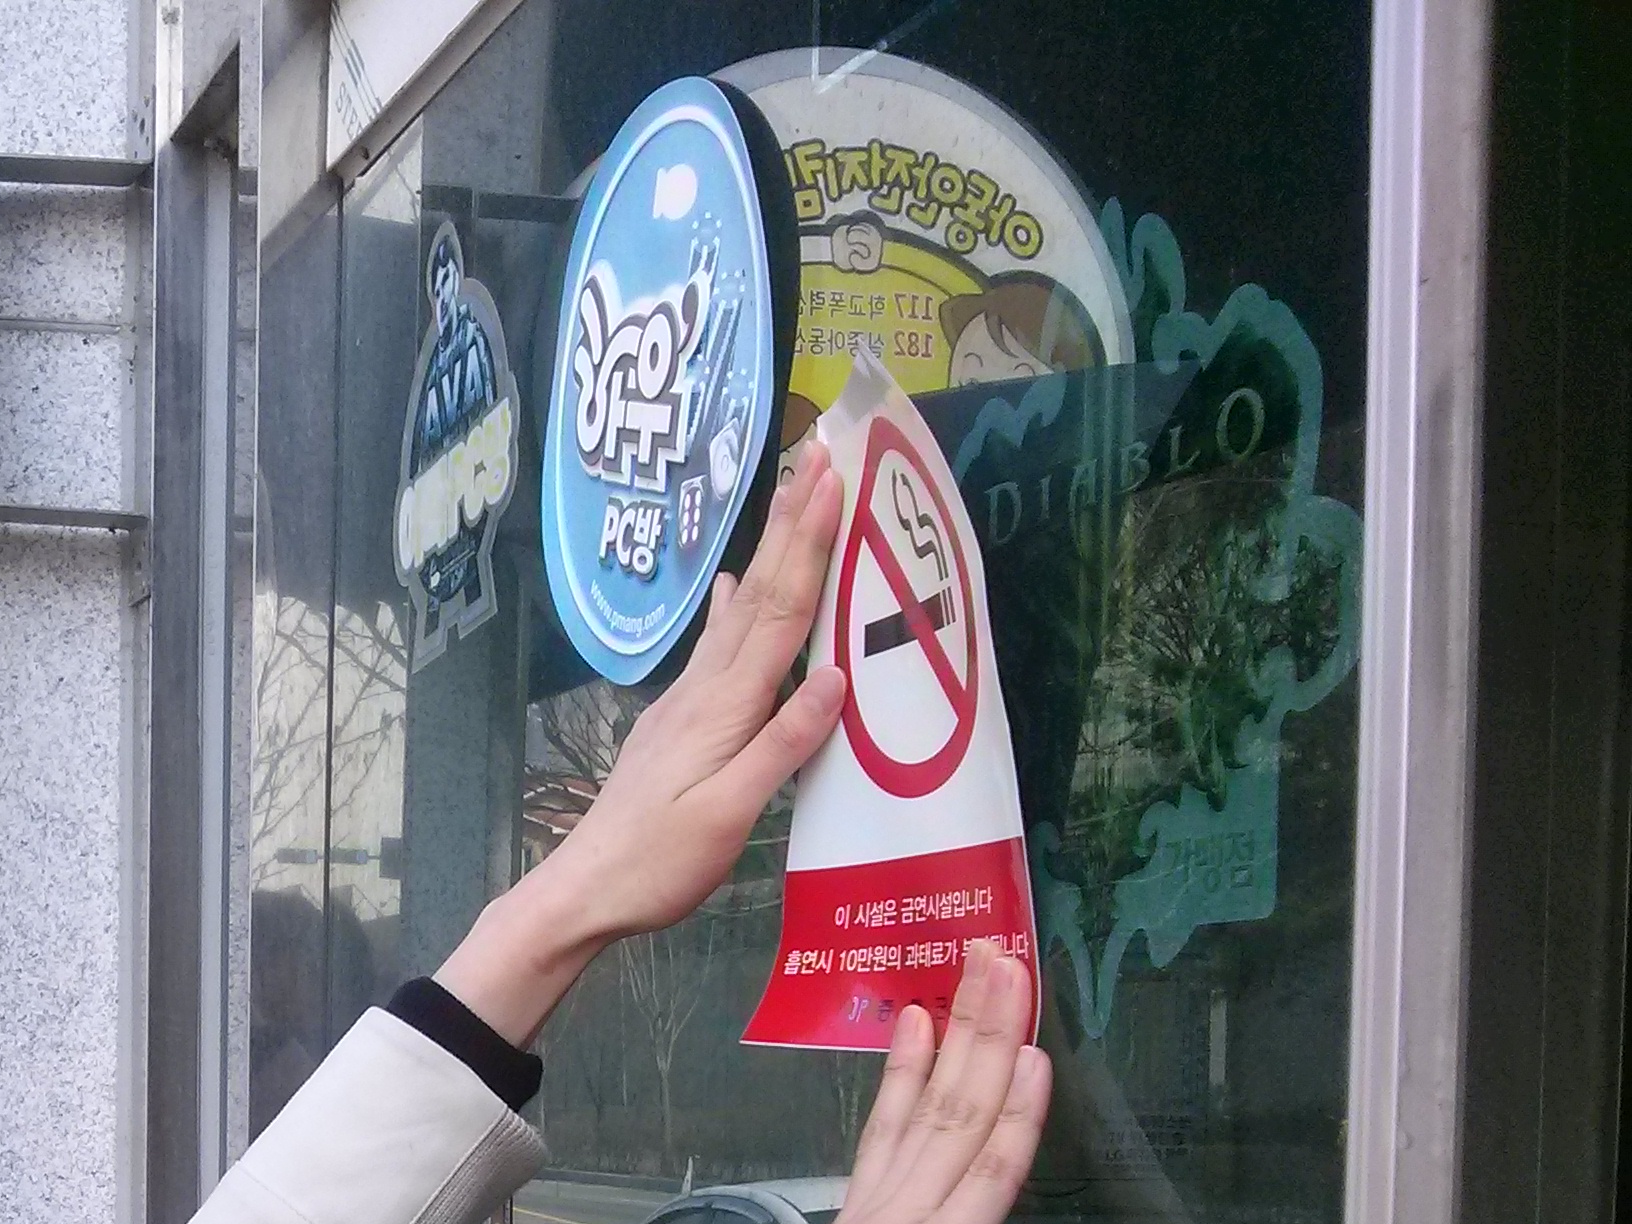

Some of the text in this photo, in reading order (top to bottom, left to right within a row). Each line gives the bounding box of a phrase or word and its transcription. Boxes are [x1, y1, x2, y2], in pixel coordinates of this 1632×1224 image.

[984, 387, 1266, 547] DIABLO
[598, 500, 664, 577] PC방
[591, 579, 665, 637] www.pmang.com
[835, 886, 993, 929] 이 시설은 금연시설입니다
[783, 949, 833, 975] 흡연시
[839, 944, 902, 973] 10만원의
[905, 938, 958, 970] 과태료가
